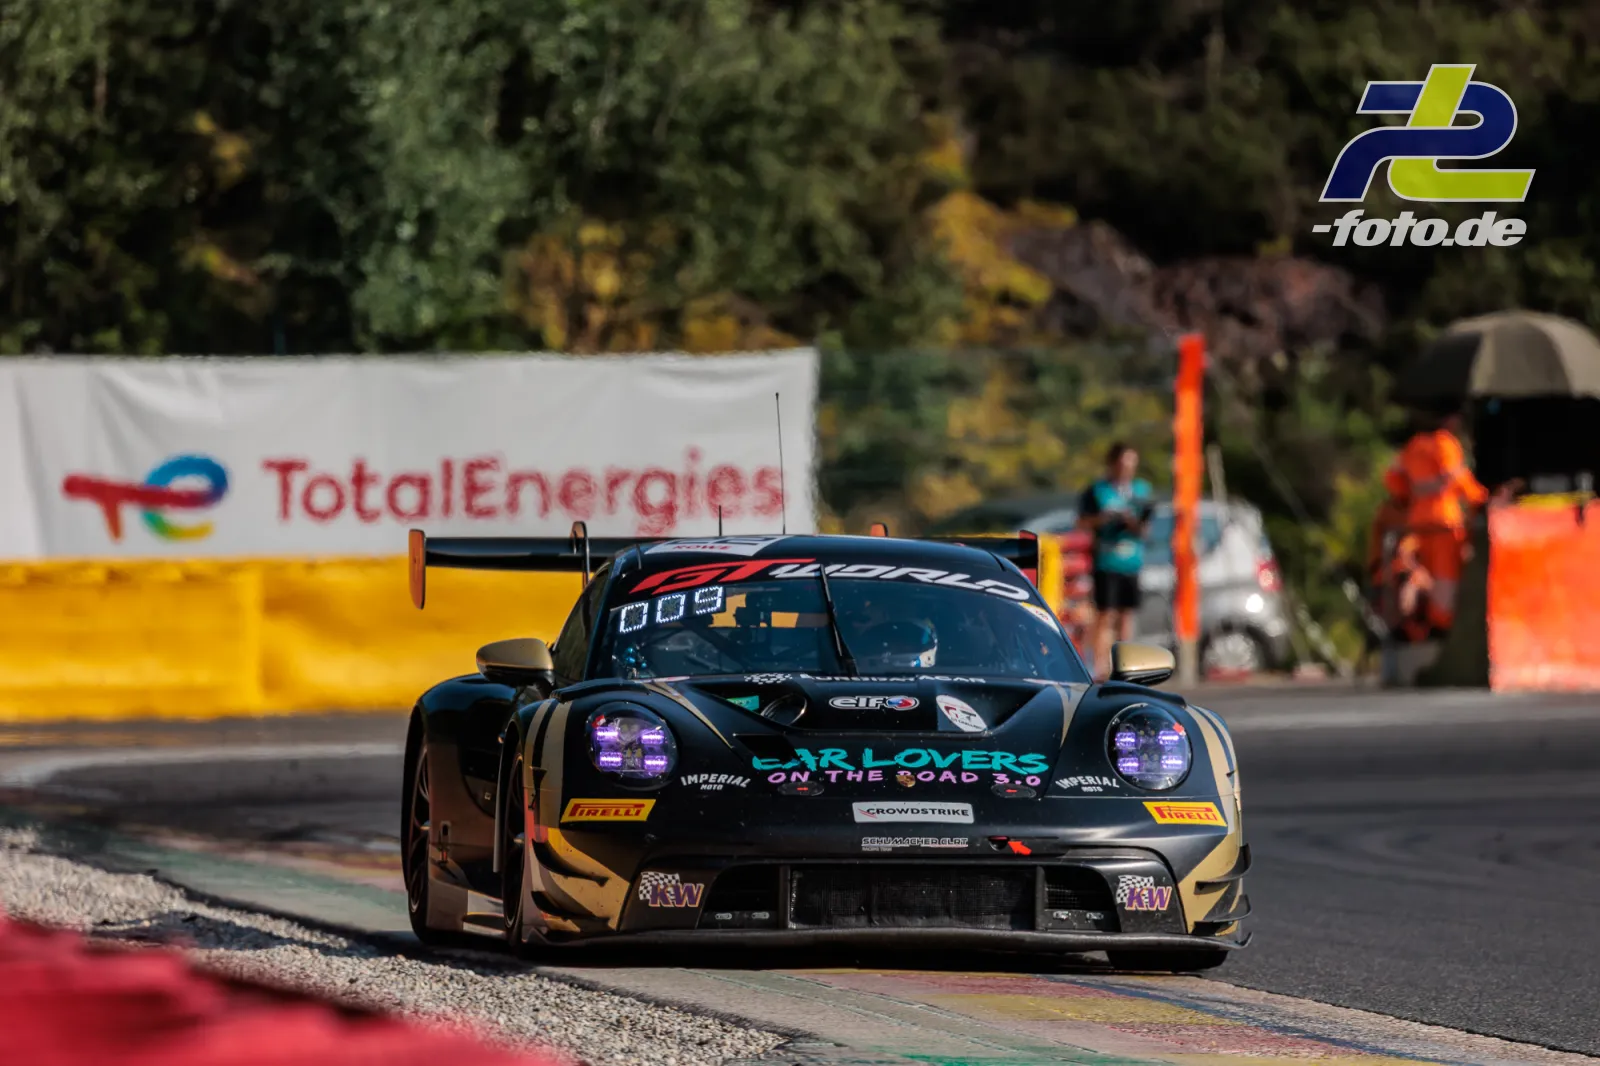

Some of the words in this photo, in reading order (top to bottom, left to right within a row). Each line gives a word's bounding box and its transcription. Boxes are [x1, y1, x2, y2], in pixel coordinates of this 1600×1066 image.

[261, 447, 786, 537] TotalEnergies
[863, 748, 1049, 774] LOVERS
[680, 773, 751, 788] IMPERIAL
[767, 771, 810, 783] ON
[825, 770, 883, 782] THE
[992, 773, 1041, 786] 3.0
[1055, 776, 1120, 789] IMPERIAL
[568, 803, 646, 817] PIRELLI
[866, 807, 970, 817] CROWDSTRIKE
[1153, 806, 1218, 821] PIRELLI
[861, 837, 939, 847] SCHUMACHER
[649, 882, 705, 908] KW
[1125, 886, 1172, 910] KW
